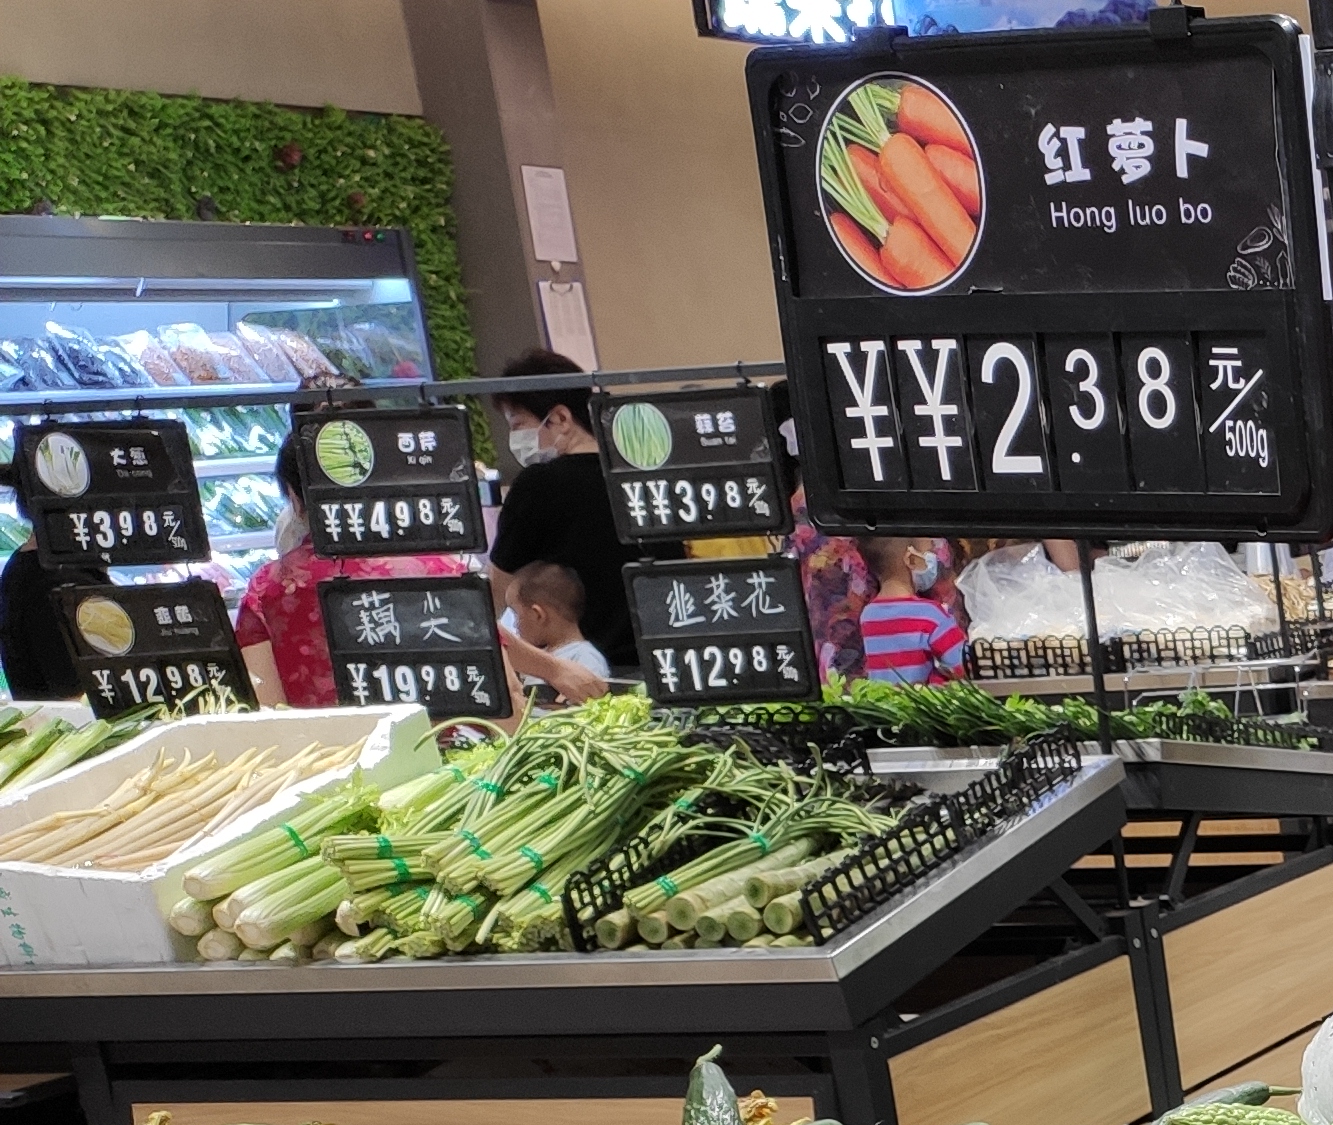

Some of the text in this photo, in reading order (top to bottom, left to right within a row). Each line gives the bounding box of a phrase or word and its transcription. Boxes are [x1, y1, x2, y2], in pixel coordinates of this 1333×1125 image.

[1037, 117, 1210, 187] 红萝卜
[1050, 199, 1213, 233] Hong luo bo
[110, 446, 149, 466] 大葱
[396, 430, 438, 453] 西芹
[351, 590, 464, 646] 藕尖
[665, 570, 787, 628] 韭菜花
